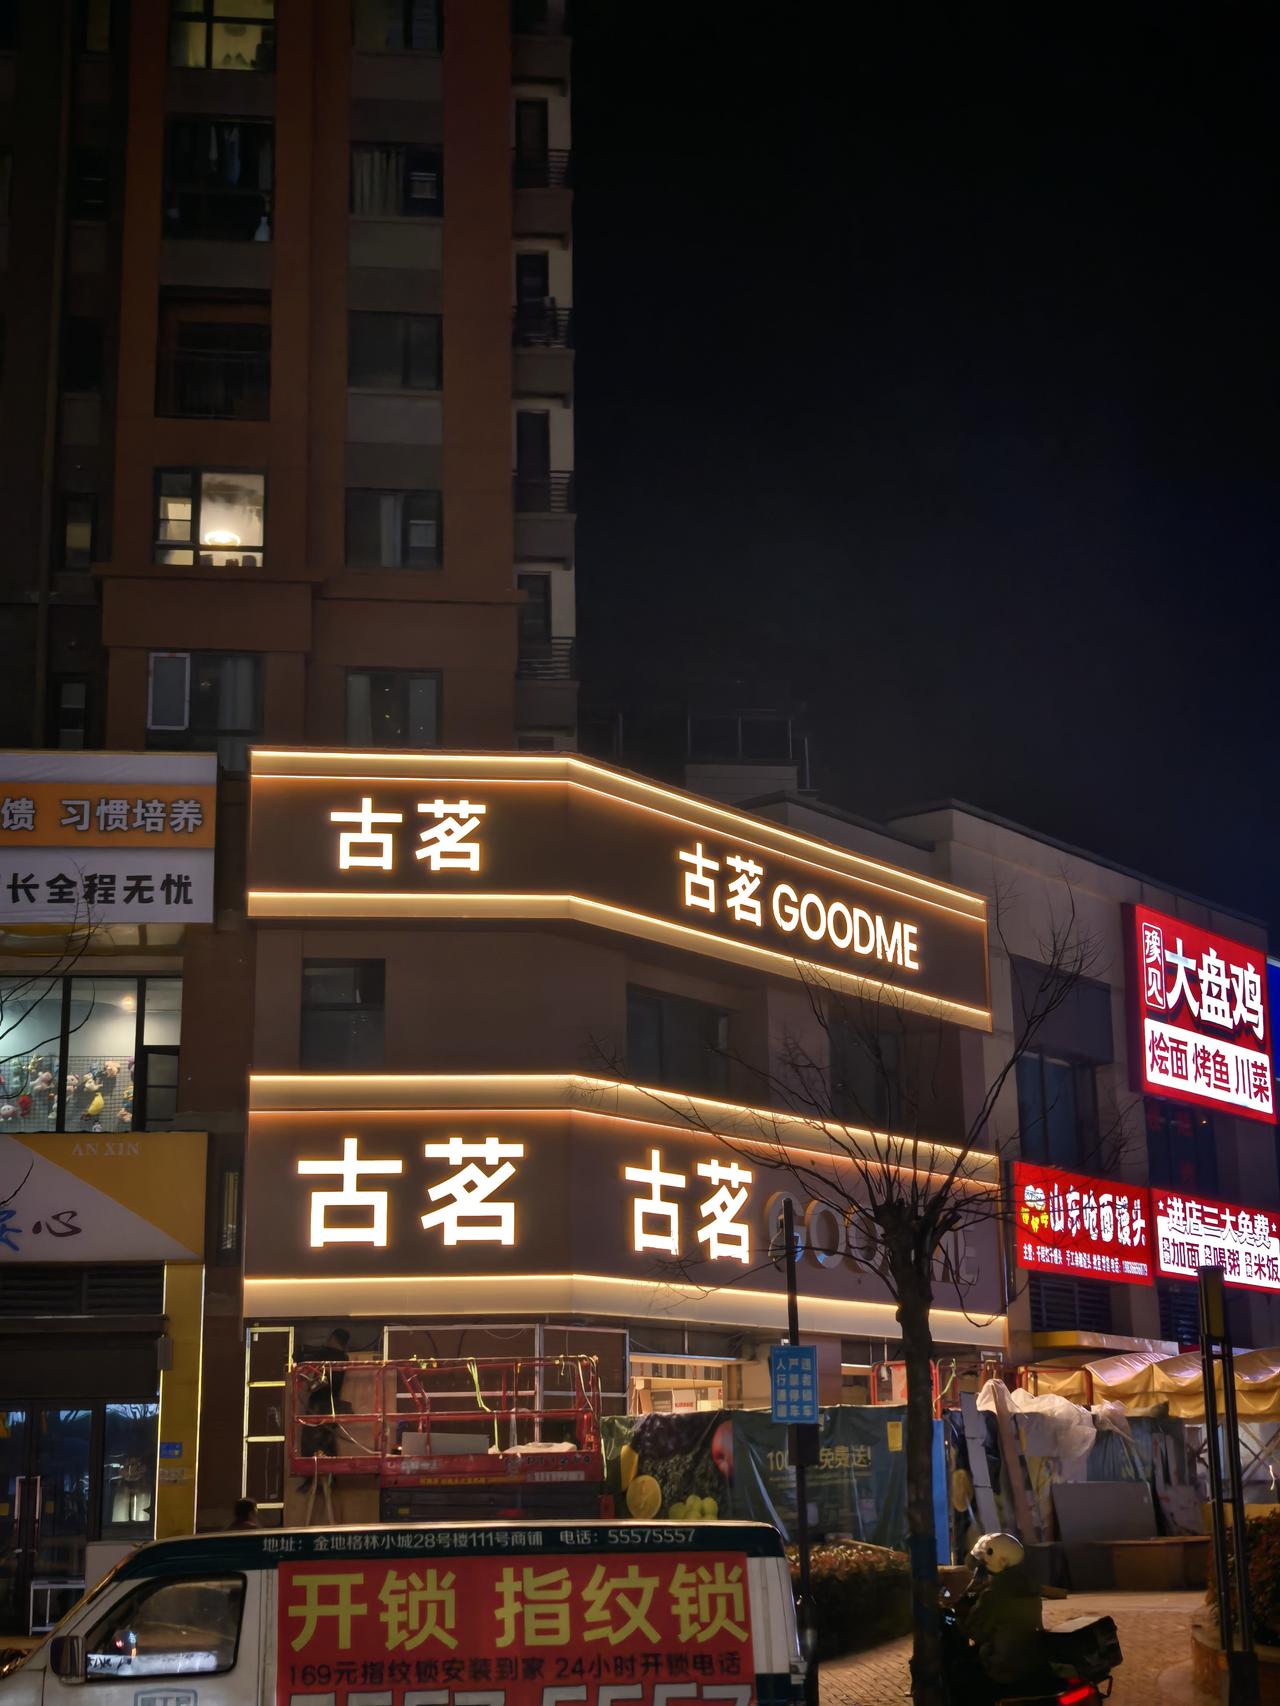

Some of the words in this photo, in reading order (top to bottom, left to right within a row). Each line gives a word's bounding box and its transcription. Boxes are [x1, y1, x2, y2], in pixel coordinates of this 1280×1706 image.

[1, 798, 35, 831] 馈
[60, 798, 203, 833] 习惯培养
[330, 797, 486, 871] 古茗
[6, 872, 194, 905] 长全程无忧
[679, 842, 764, 927] 古茗
[772, 883, 919, 970] GOODME
[1165, 937, 1265, 1041] 大盘鸡
[1149, 1030, 1189, 1081] 烩面
[1193, 1043, 1231, 1093] 烤鱼
[1235, 1055, 1270, 1103] 川菜
[104, 1142, 140, 1155] XIN
[297, 1137, 525, 1247] 古茗
[625, 1149, 753, 1264] 古茗
[767, 1191, 977, 1285] GOOE
[1167, 1197, 1271, 1249] 进店三大免费
[1171, 1238, 1200, 1271] 加面
[1254, 1253, 1280, 1283] 米饭
[263, 1538, 304, 1552] 地址:
[313, 1530, 543, 1552] 金地格林小城28号楼111号商铺
[560, 1529, 599, 1545] 电话:
[608, 1528, 695, 1545] 55575557
[288, 1569, 458, 1652] 开锁
[494, 1562, 749, 1648] 指纹锁
[290, 1658, 545, 1687] 169元指纹锁安装到家
[556, 1651, 742, 1681] 24小时开锁电话
